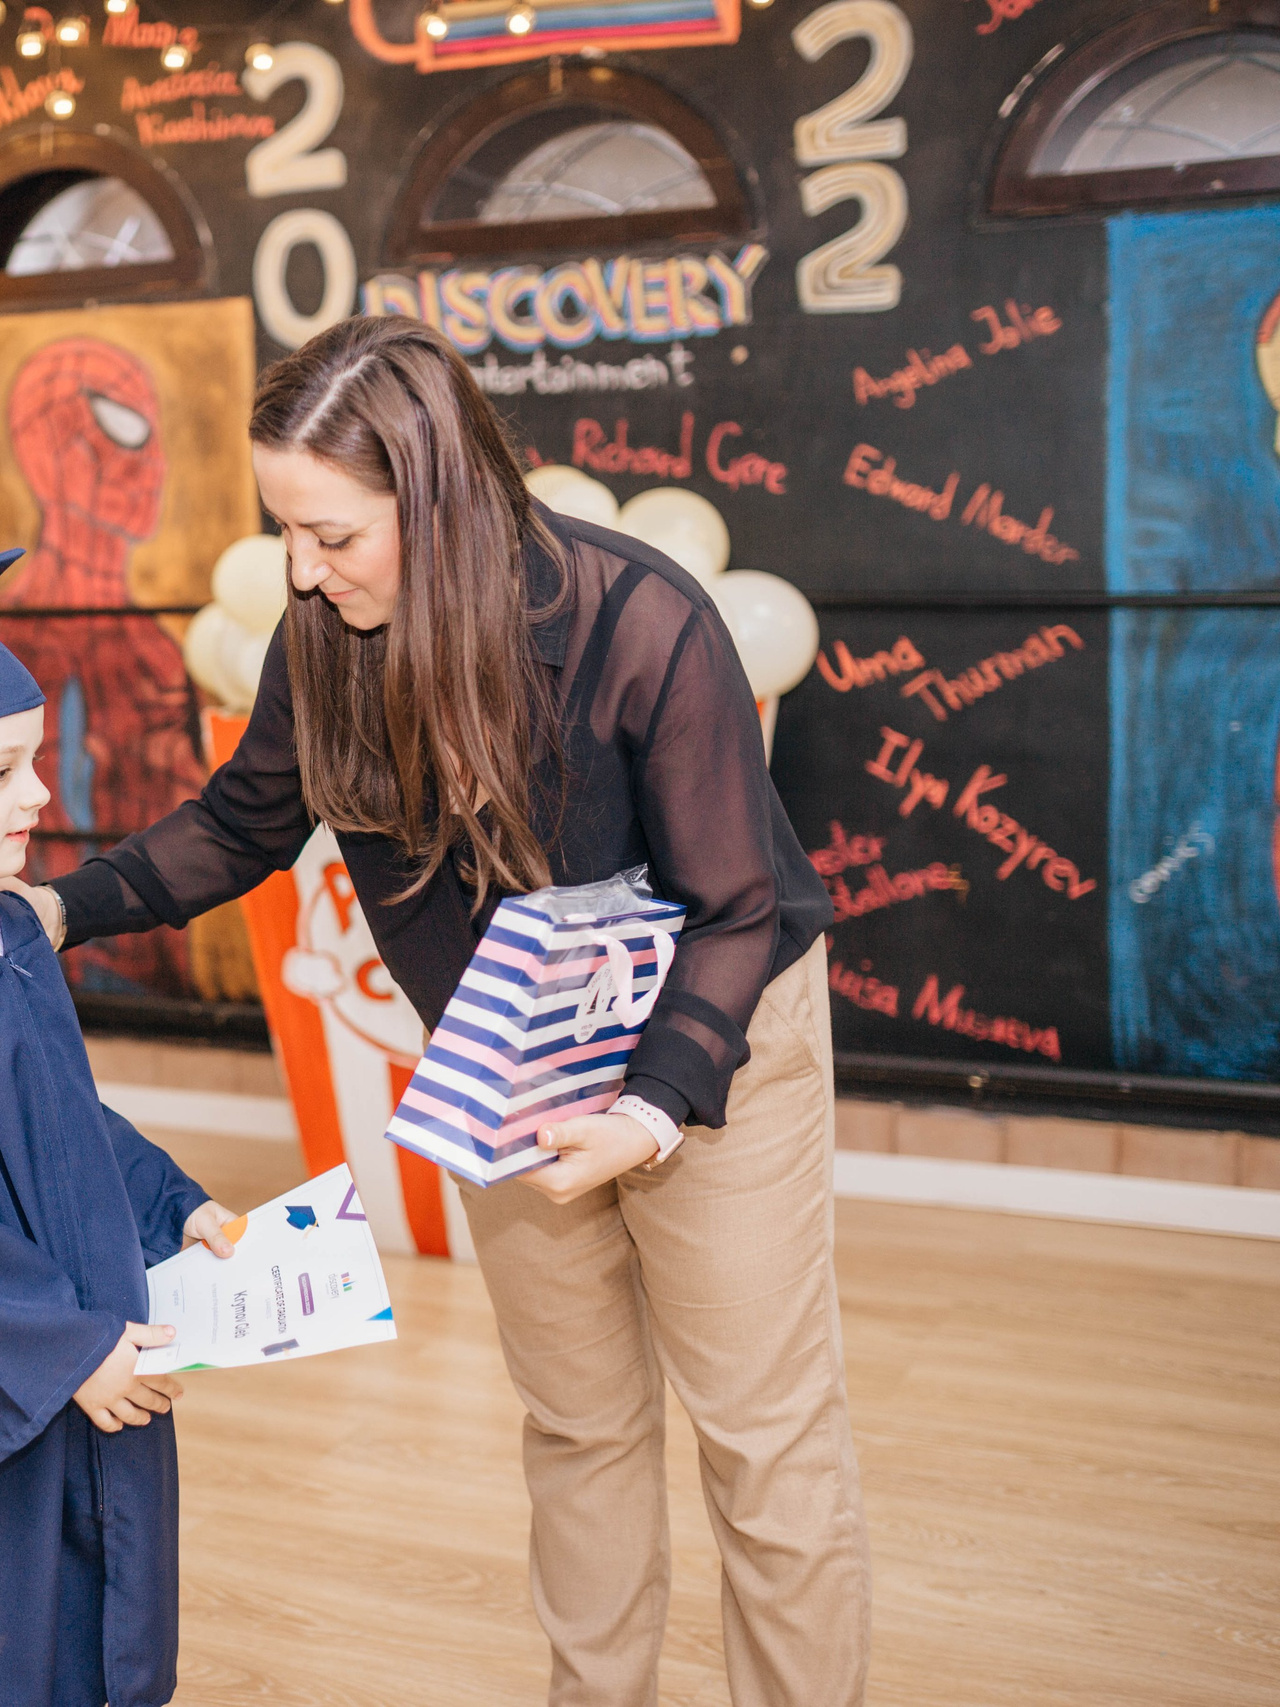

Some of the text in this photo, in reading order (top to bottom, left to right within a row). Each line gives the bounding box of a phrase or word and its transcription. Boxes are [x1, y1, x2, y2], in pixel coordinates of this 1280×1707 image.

[361, 243, 768, 354] DISCOVERY
[464, 340, 696, 396] ntertainment
[852, 297, 1064, 410] Angelina Jolie
[572, 410, 695, 479] Richard
[843, 442, 962, 522] Edward
[816, 638, 925, 693] Uma
[900, 624, 1085, 722] Thurman
[952, 763, 1098, 901] Kozyrev
[825, 940, 900, 1018] uisa
[231, 1290, 250, 1339] Krymov Gleb
[271, 1265, 283, 1300] CERTIFICATE
[276, 1308, 286, 1335] GRADUATION
